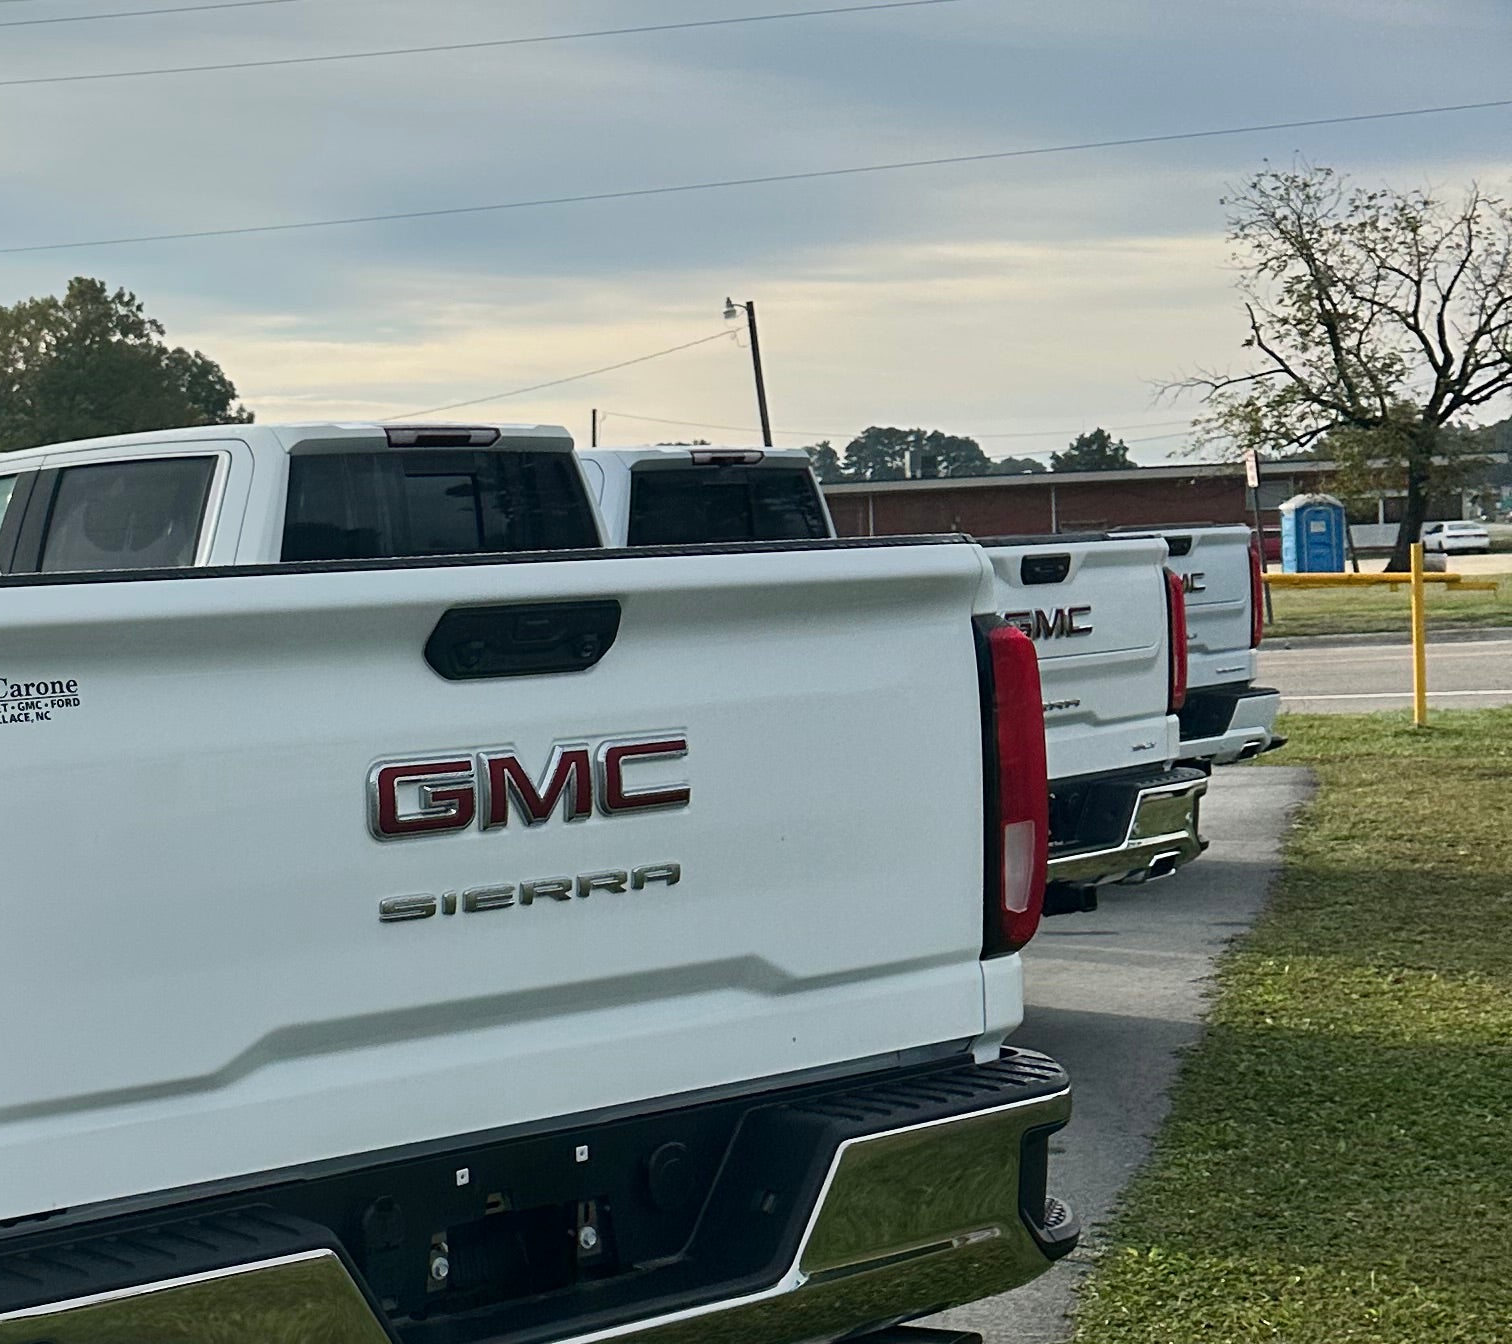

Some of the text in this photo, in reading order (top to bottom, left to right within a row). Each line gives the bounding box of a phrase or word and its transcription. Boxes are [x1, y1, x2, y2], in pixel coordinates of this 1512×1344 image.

[18, 700, 43, 712] GMC
[50, 697, 81, 709] FORD
[36, 710, 52, 722] NC
[365, 728, 691, 843] GMC
[378, 862, 682, 923] SIERRA
